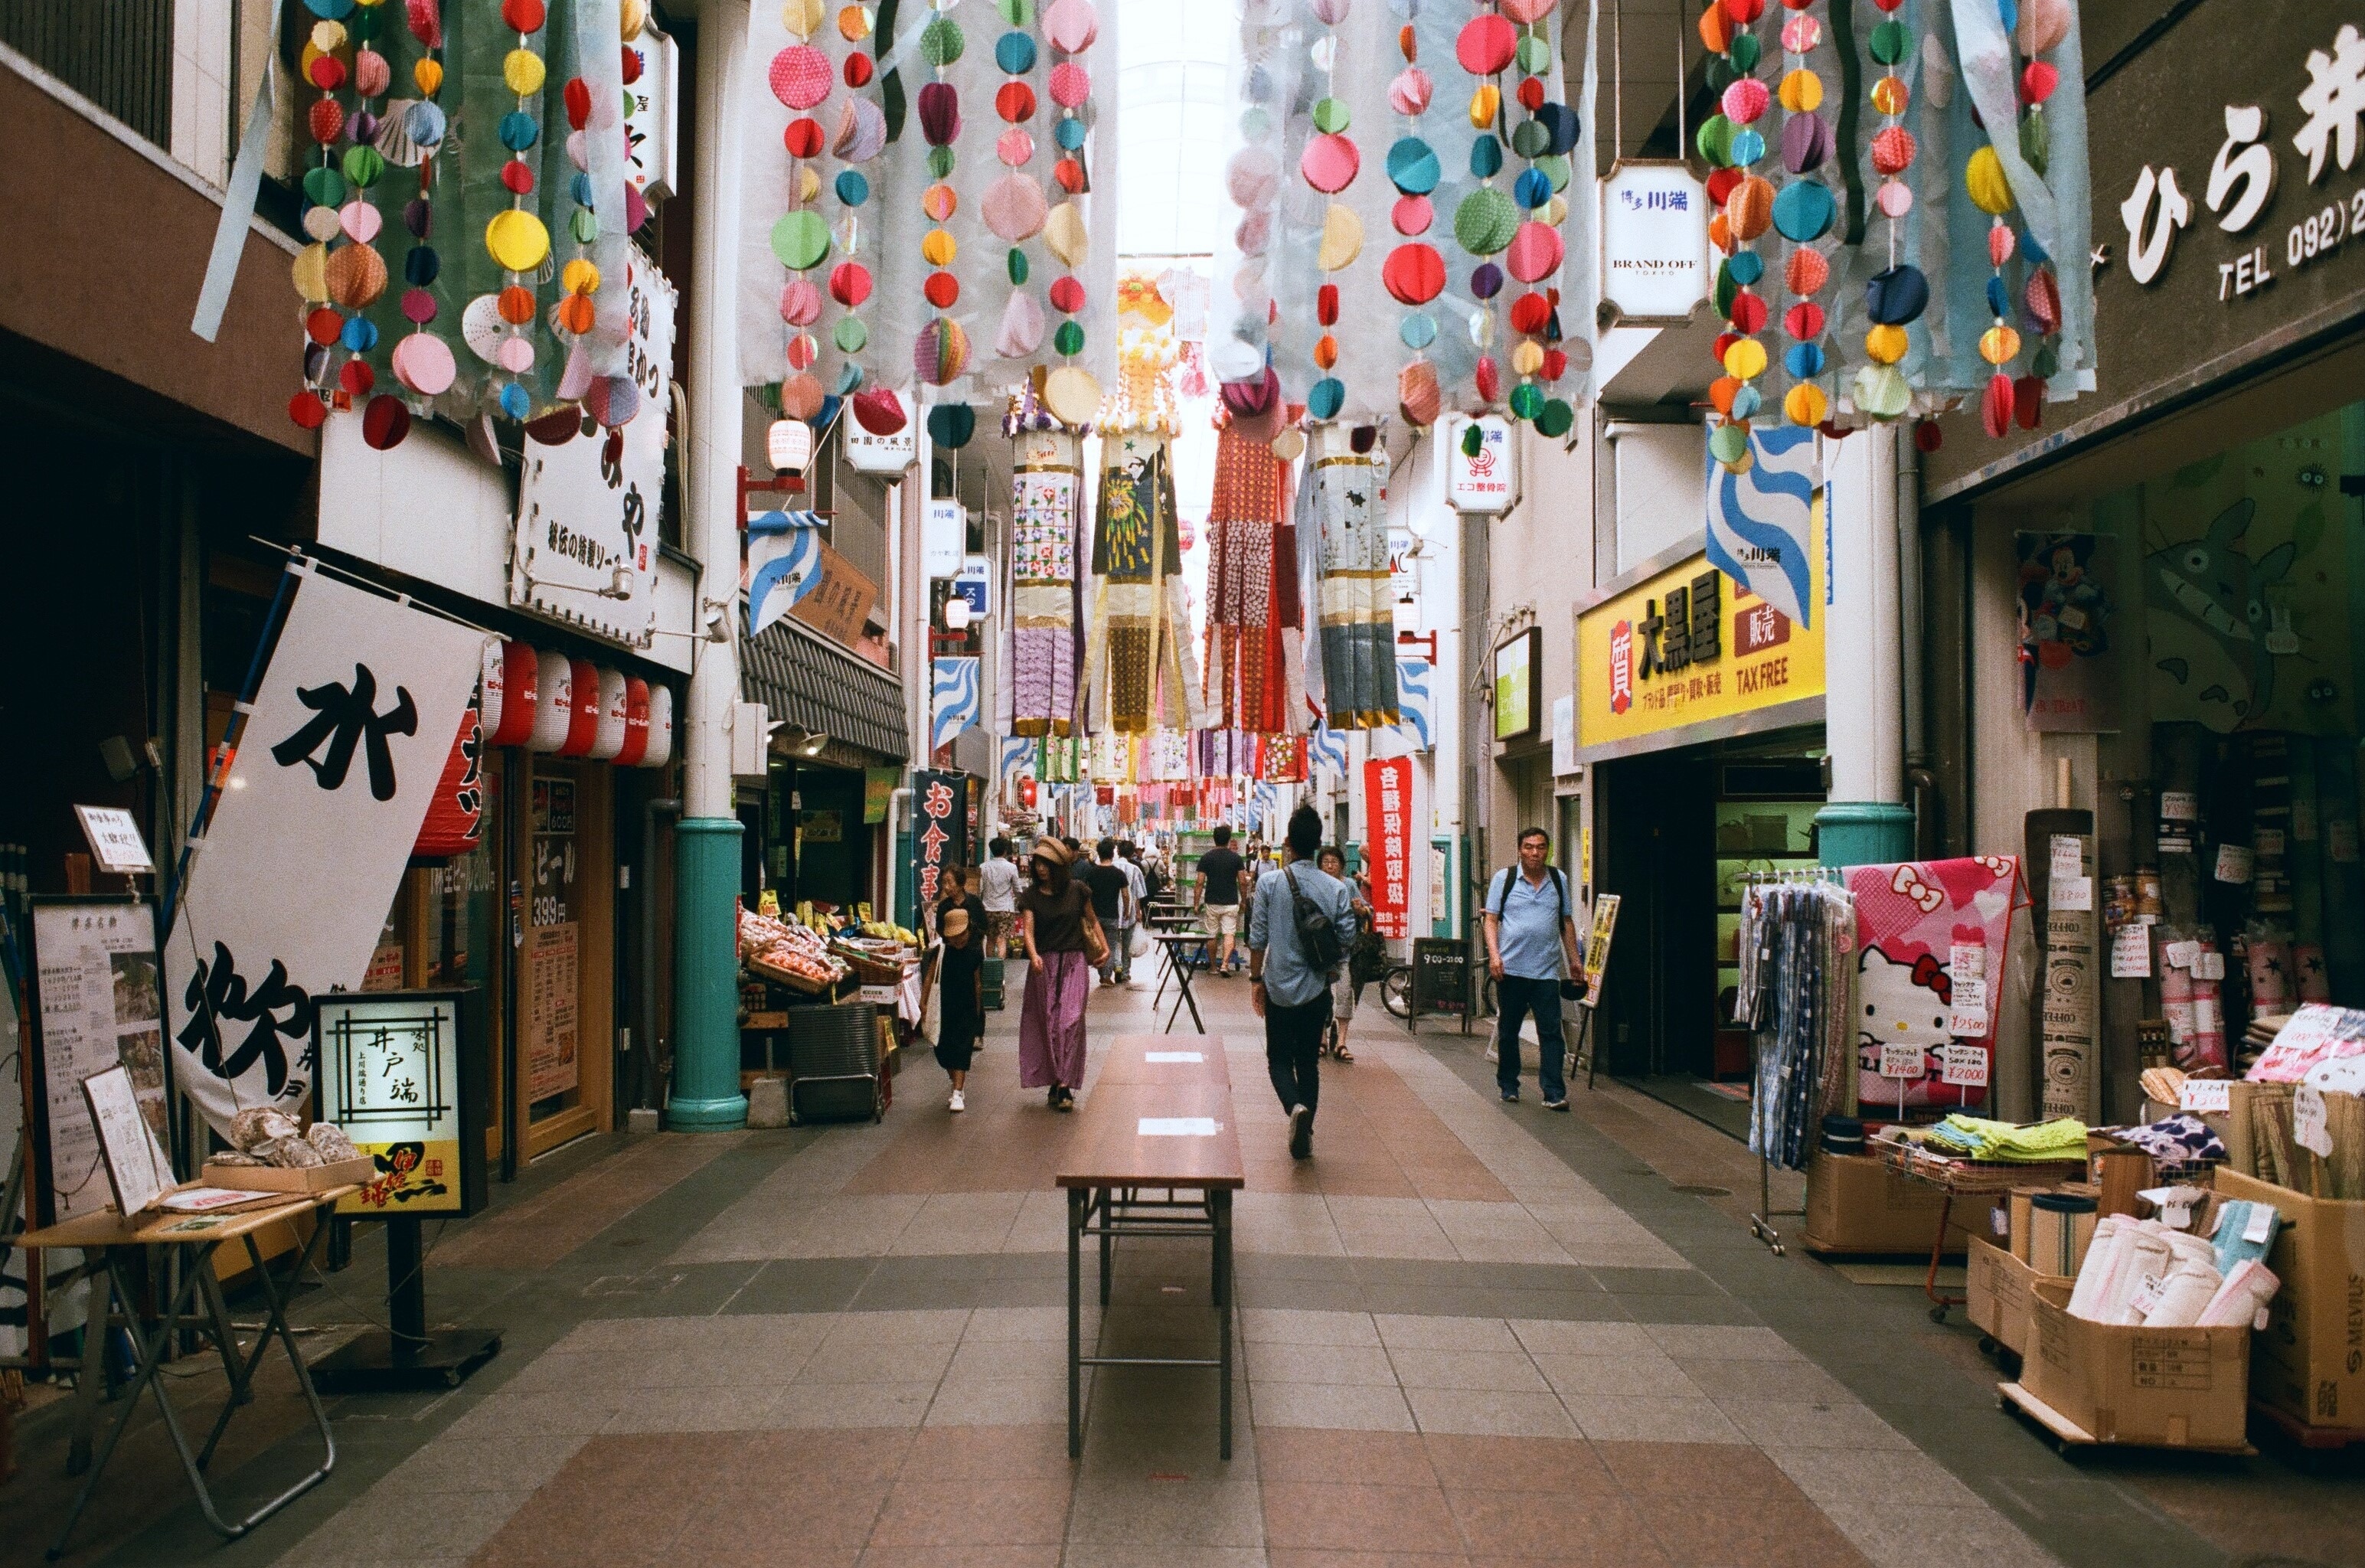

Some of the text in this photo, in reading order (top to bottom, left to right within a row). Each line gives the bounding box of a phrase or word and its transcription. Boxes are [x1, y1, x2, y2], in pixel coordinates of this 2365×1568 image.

[1622, 190, 1687, 211] 博多川端
[1613, 260, 1697, 269] BRAND OFF
[2220, 247, 2271, 301] TEL
[851, 435, 913, 446] 田園の風景
[1456, 482, 1507, 493] エコ整骨院
[1638, 568, 1722, 681] 大黒屋
[1736, 656, 1789, 696] TAX FREE
[920, 780, 954, 904] お食事
[533, 895, 567, 926] 399円
[358, 1050, 367, 1106] 上川端通り店
[367, 1025, 419, 1104] 井戸端
[1886, 1063, 1919, 1074] ¥1400
[1948, 1066, 1984, 1080] ¥2000
